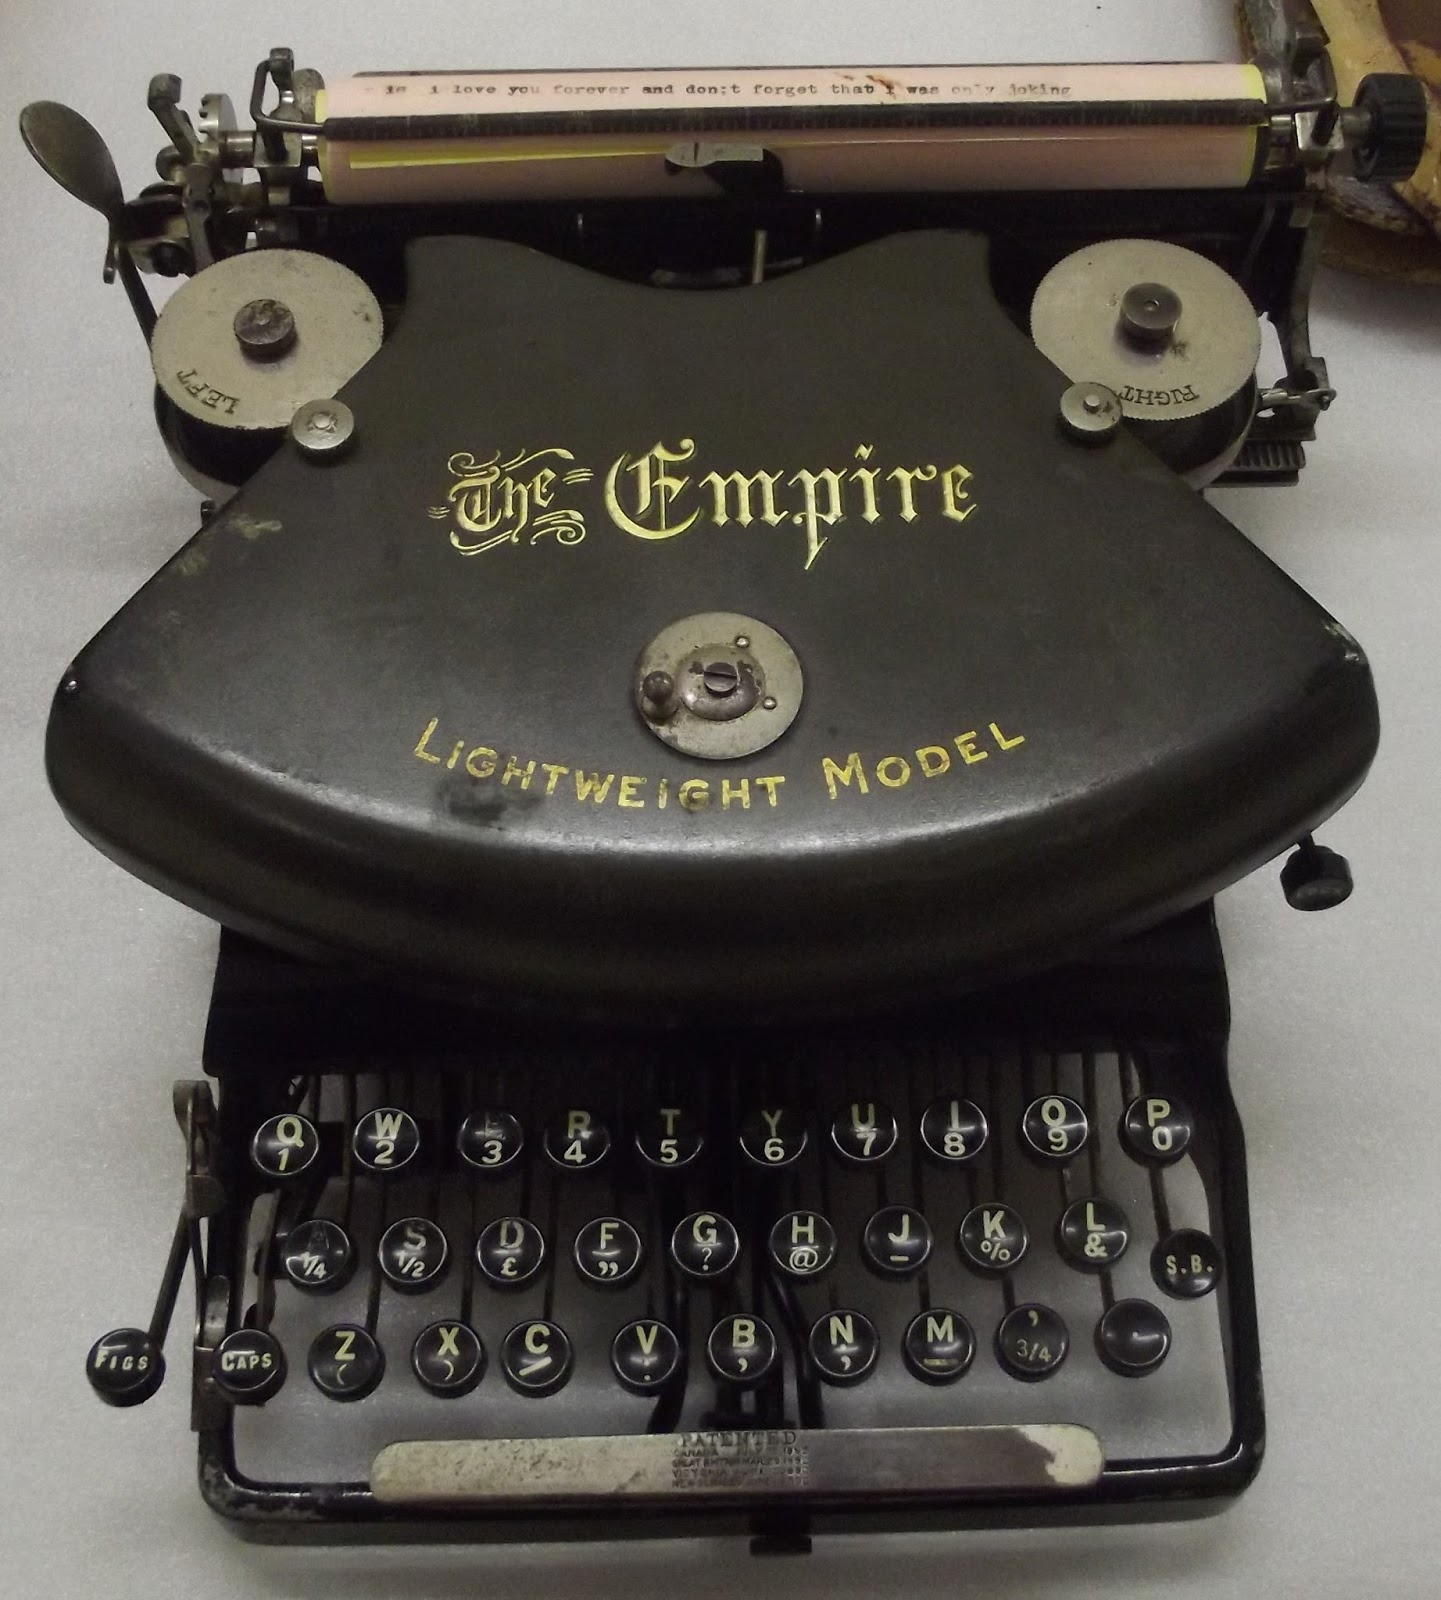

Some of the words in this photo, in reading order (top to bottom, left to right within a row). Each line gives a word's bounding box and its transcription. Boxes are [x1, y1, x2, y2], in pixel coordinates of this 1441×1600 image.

[453, 84, 496, 95] love
[508, 84, 540, 96] you
[553, 83, 630, 95] forever
[641, 83, 673, 95] and
[753, 83, 818, 97] forget
[831, 83, 874, 95] that
[907, 84, 939, 95] was
[1008, 83, 1072, 97] joking
[176, 369, 240, 414] LEFT
[1118, 384, 1200, 406] RIGHT
[429, 448, 593, 556] The
[605, 439, 978, 570] Empire
[374, 1111, 403, 1140] W
[567, 1110, 591, 1139] R
[660, 1108, 682, 1135] T
[762, 1109, 783, 1138] Y
[851, 1103, 875, 1129] U
[1146, 1099, 1171, 1127] P
[276, 1116, 304, 1148] Q
[856, 1131, 877, 1156] 7
[944, 1133, 966, 1157] 8
[1047, 1129, 1069, 1152] 9
[277, 1148, 289, 1171] 1
[374, 1139, 394, 1165] 2
[481, 1140, 503, 1164] 3
[564, 1139, 587, 1164] 4
[660, 1139, 678, 1163] 5
[763, 1137, 785, 1161] 6
[692, 1214, 717, 1246] G
[791, 1215, 815, 1245] H
[888, 1214, 909, 1243] J
[982, 1210, 1005, 1239] K
[1087, 1202, 1106, 1232] L
[403, 1221, 427, 1250] S
[500, 1221, 524, 1249] D
[599, 1222, 620, 1249] F
[1166, 1254, 1213, 1275] S.B.
[437, 1326, 459, 1356] X
[524, 1323, 550, 1354] C
[636, 1325, 658, 1354] V
[732, 1319, 756, 1348] B
[829, 1315, 854, 1345] N
[927, 1315, 954, 1343] M
[334, 1330, 356, 1360] Z
[1016, 1339, 1050, 1362] 3/4
[94, 1348, 149, 1371] FIGS
[221, 1351, 272, 1372] CAPS
